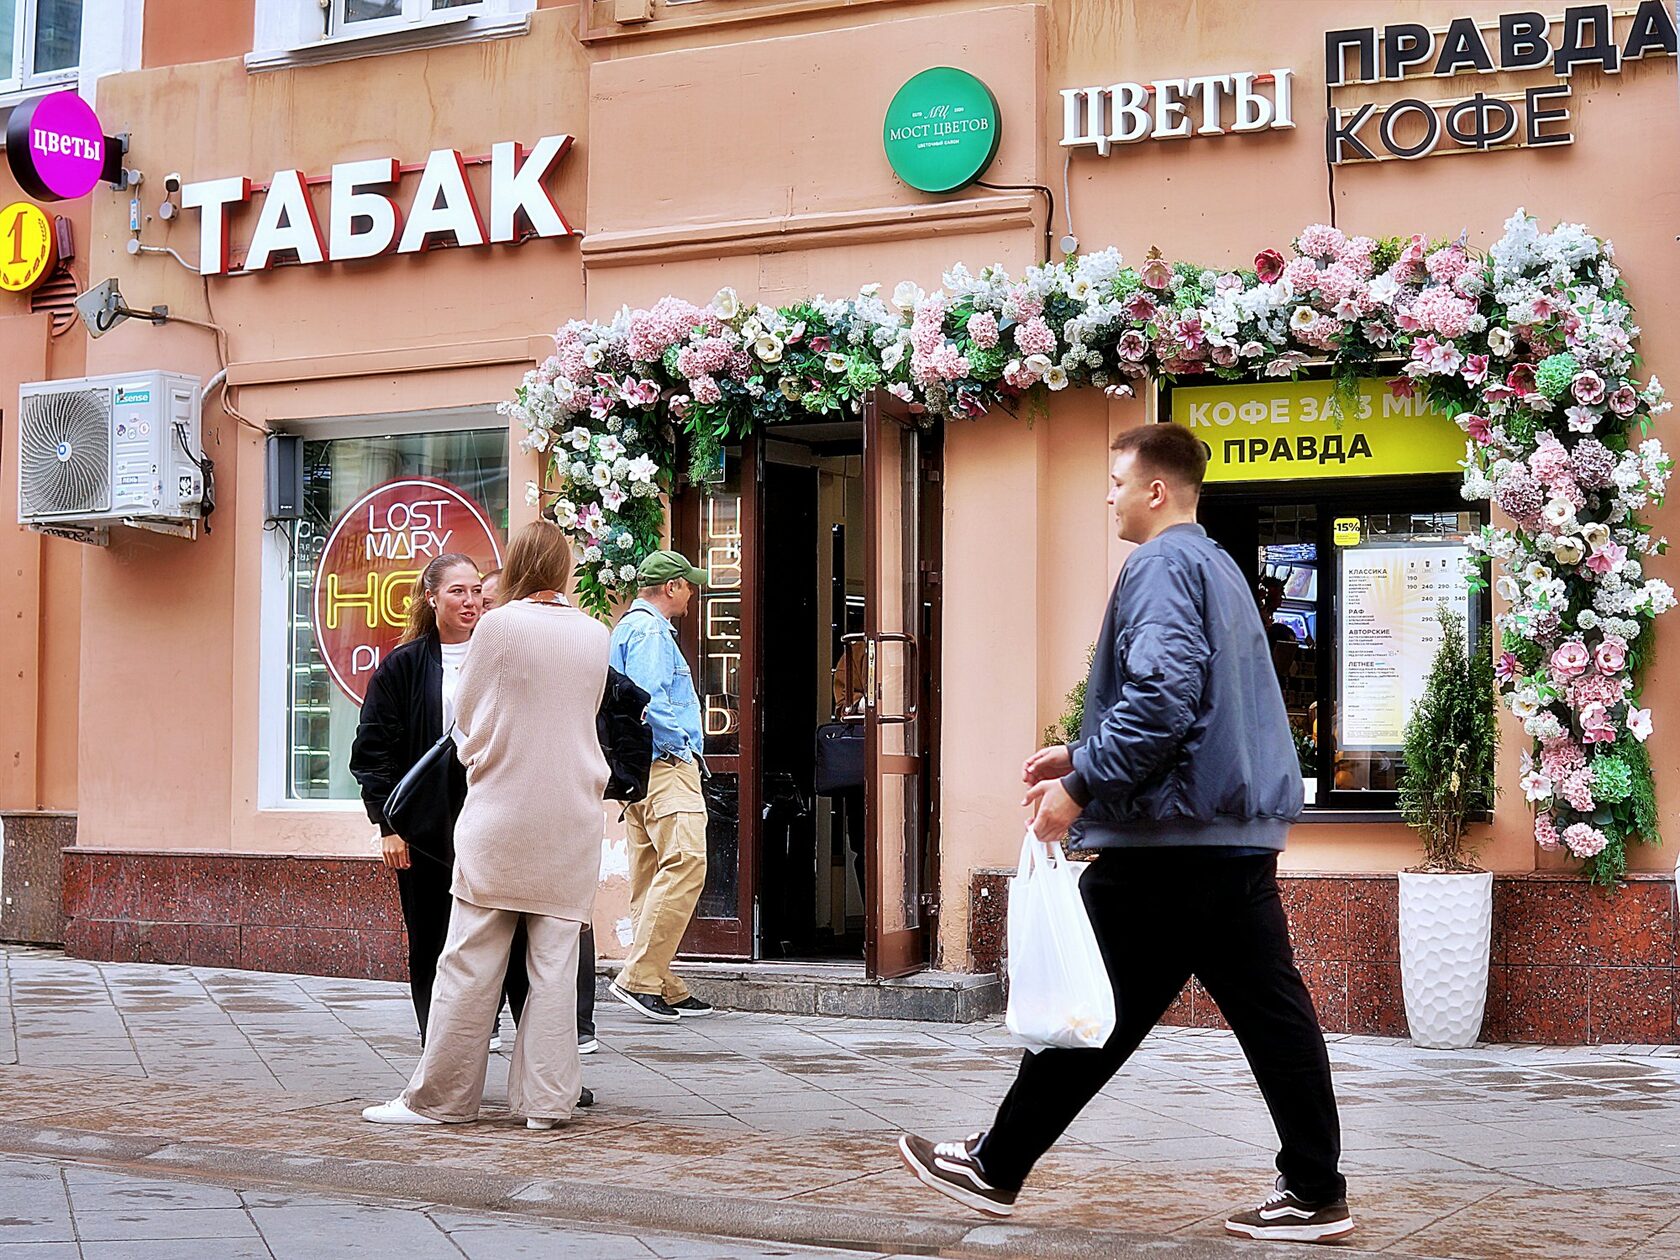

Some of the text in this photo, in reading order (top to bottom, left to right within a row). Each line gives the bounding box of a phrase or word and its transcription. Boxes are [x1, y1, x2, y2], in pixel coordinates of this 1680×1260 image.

[1324, 0, 1678, 87] ПРАВДА
[890, 118, 989, 141] МОСТ ЦВЕТОВ
[1059, 68, 1296, 157] ЦВЕТЫ
[1327, 84, 1575, 165] КОФЕ
[181, 133, 576, 276] ТАБАК
[1189, 398, 1290, 428] КОФЕ
[1299, 396, 1343, 423] ЗА
[1382, 392, 1447, 418] МИ
[1223, 433, 1372, 465] ПРАВДА
[368, 500, 450, 533] LOST
[365, 529, 453, 561] MARY
